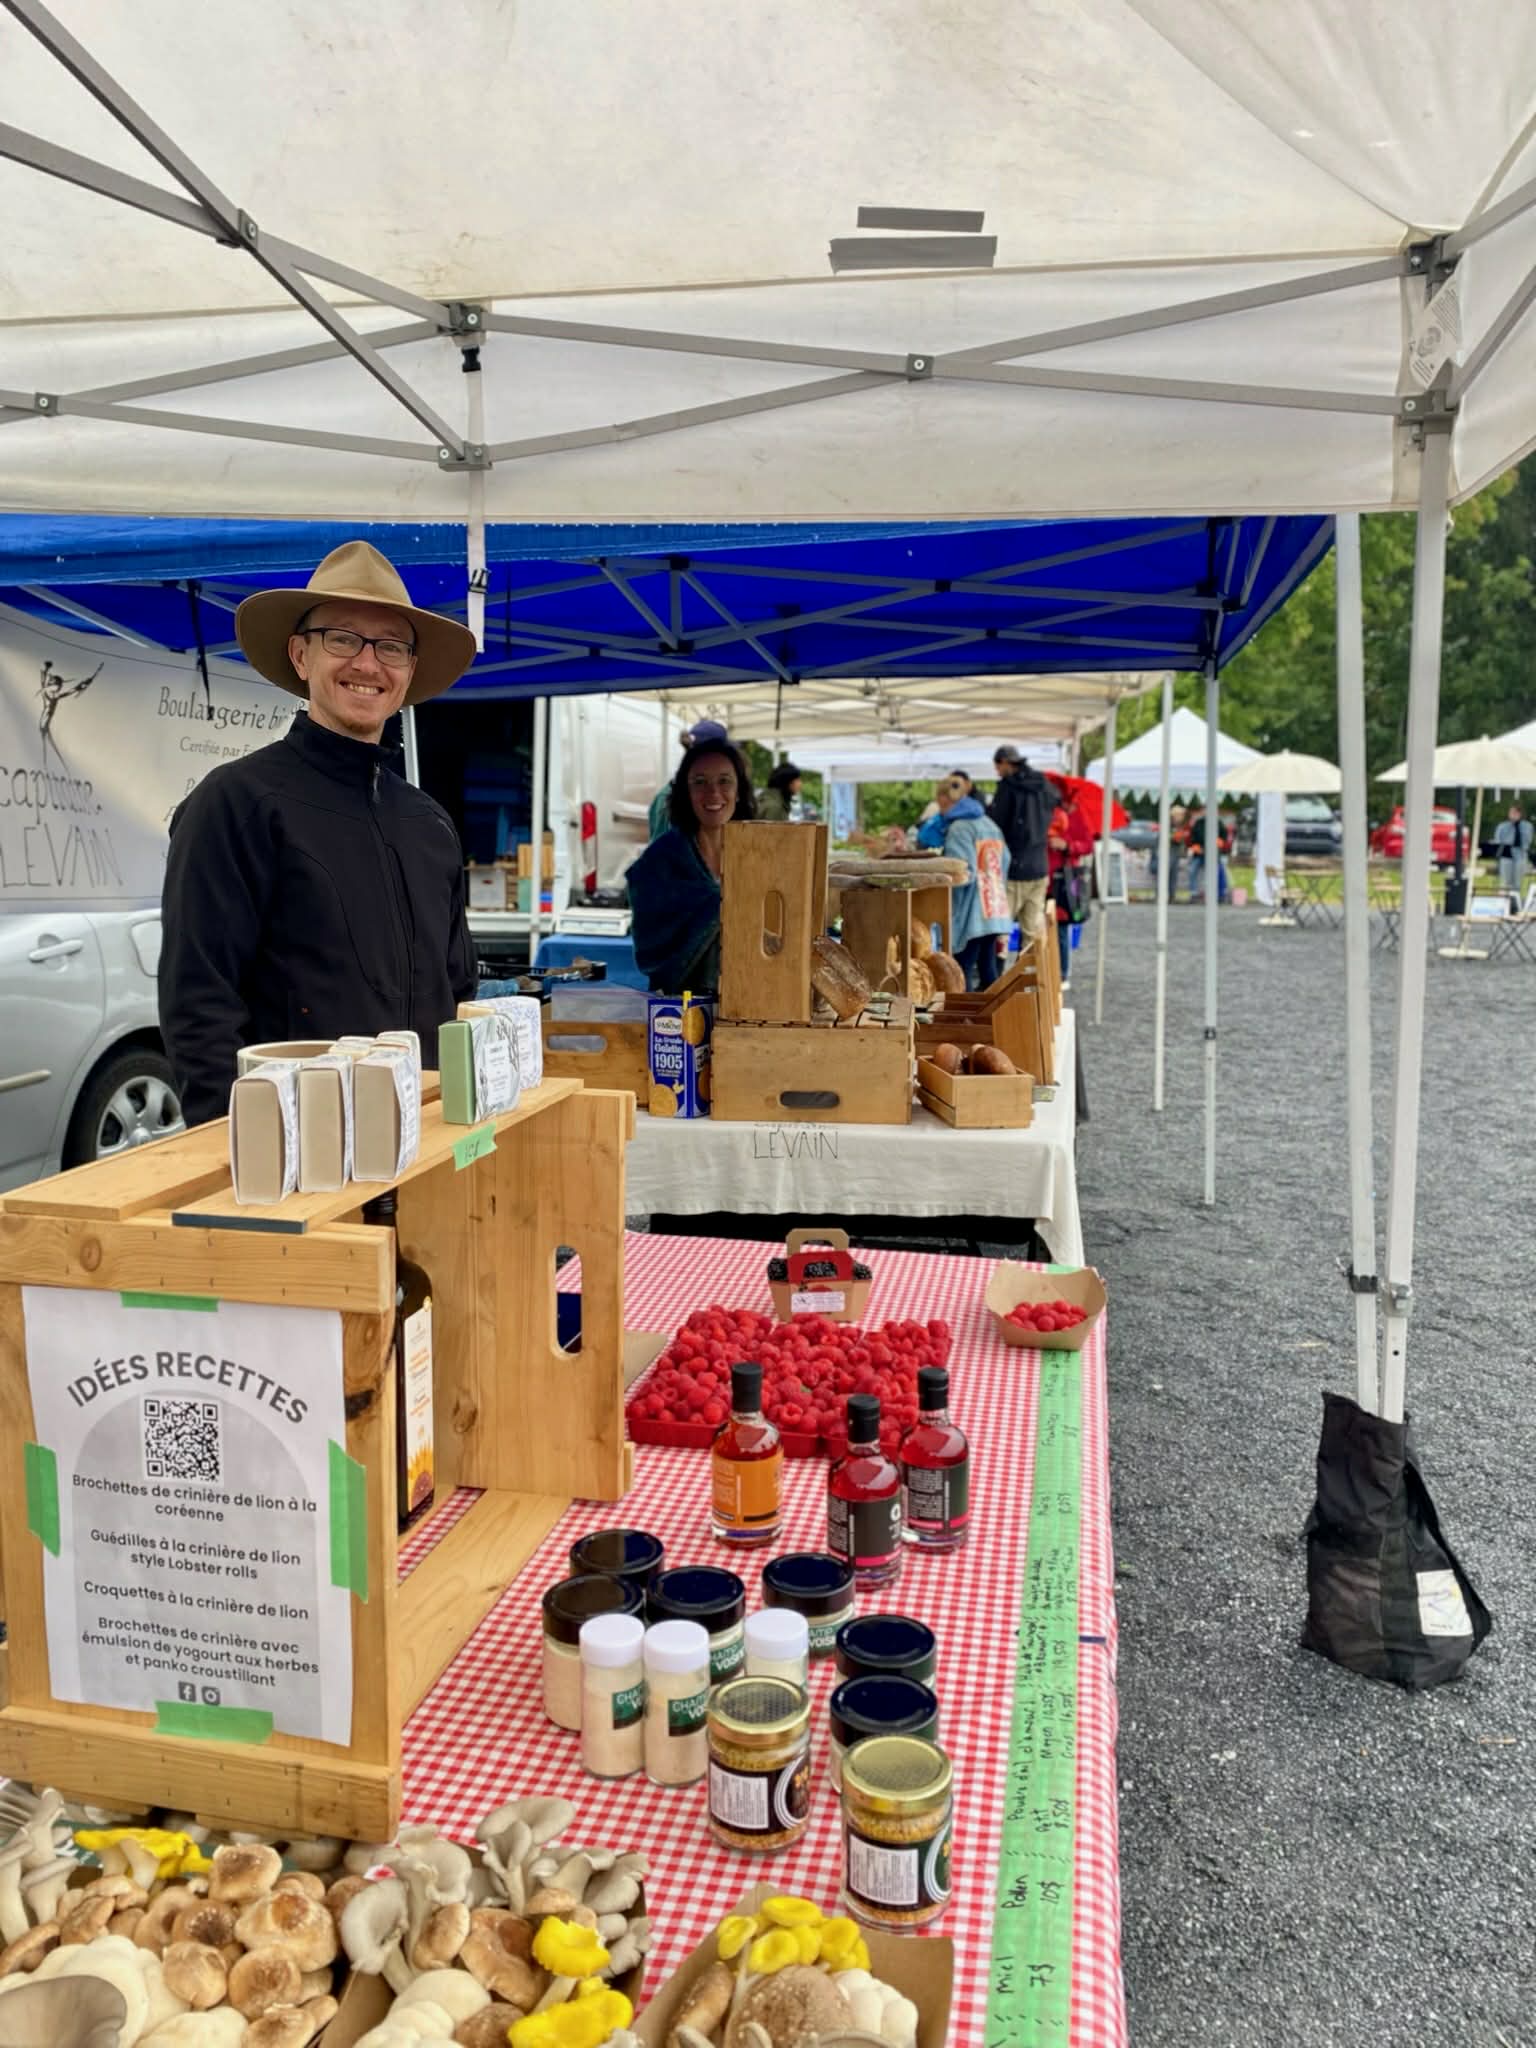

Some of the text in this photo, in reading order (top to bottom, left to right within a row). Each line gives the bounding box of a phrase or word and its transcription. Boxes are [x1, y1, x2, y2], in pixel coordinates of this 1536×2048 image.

[655, 1054, 683, 1070] 1905
[67, 1351, 310, 1425] IDÉES RECETTES
[72, 1474, 317, 1513] Brochettes de crinière de lion à la
[155, 1503, 224, 1523] coréenne
[90, 1529, 301, 1566] Guédilles à la crinière de lion
[130, 1551, 258, 1580] style Lobster rolls
[84, 1581, 309, 1620] Croquettes à la crinière de lion
[82, 1631, 319, 1674] émulsion de yogourt aux herbes
[98, 1616, 299, 1654] Brochettes de crinière avec
[125, 1654, 276, 1688] et panko croustillant
[1035, 1880, 1064, 1906] 10$
[994, 1956, 1016, 1994] Miel
[1025, 1963, 1055, 1988] 7$
